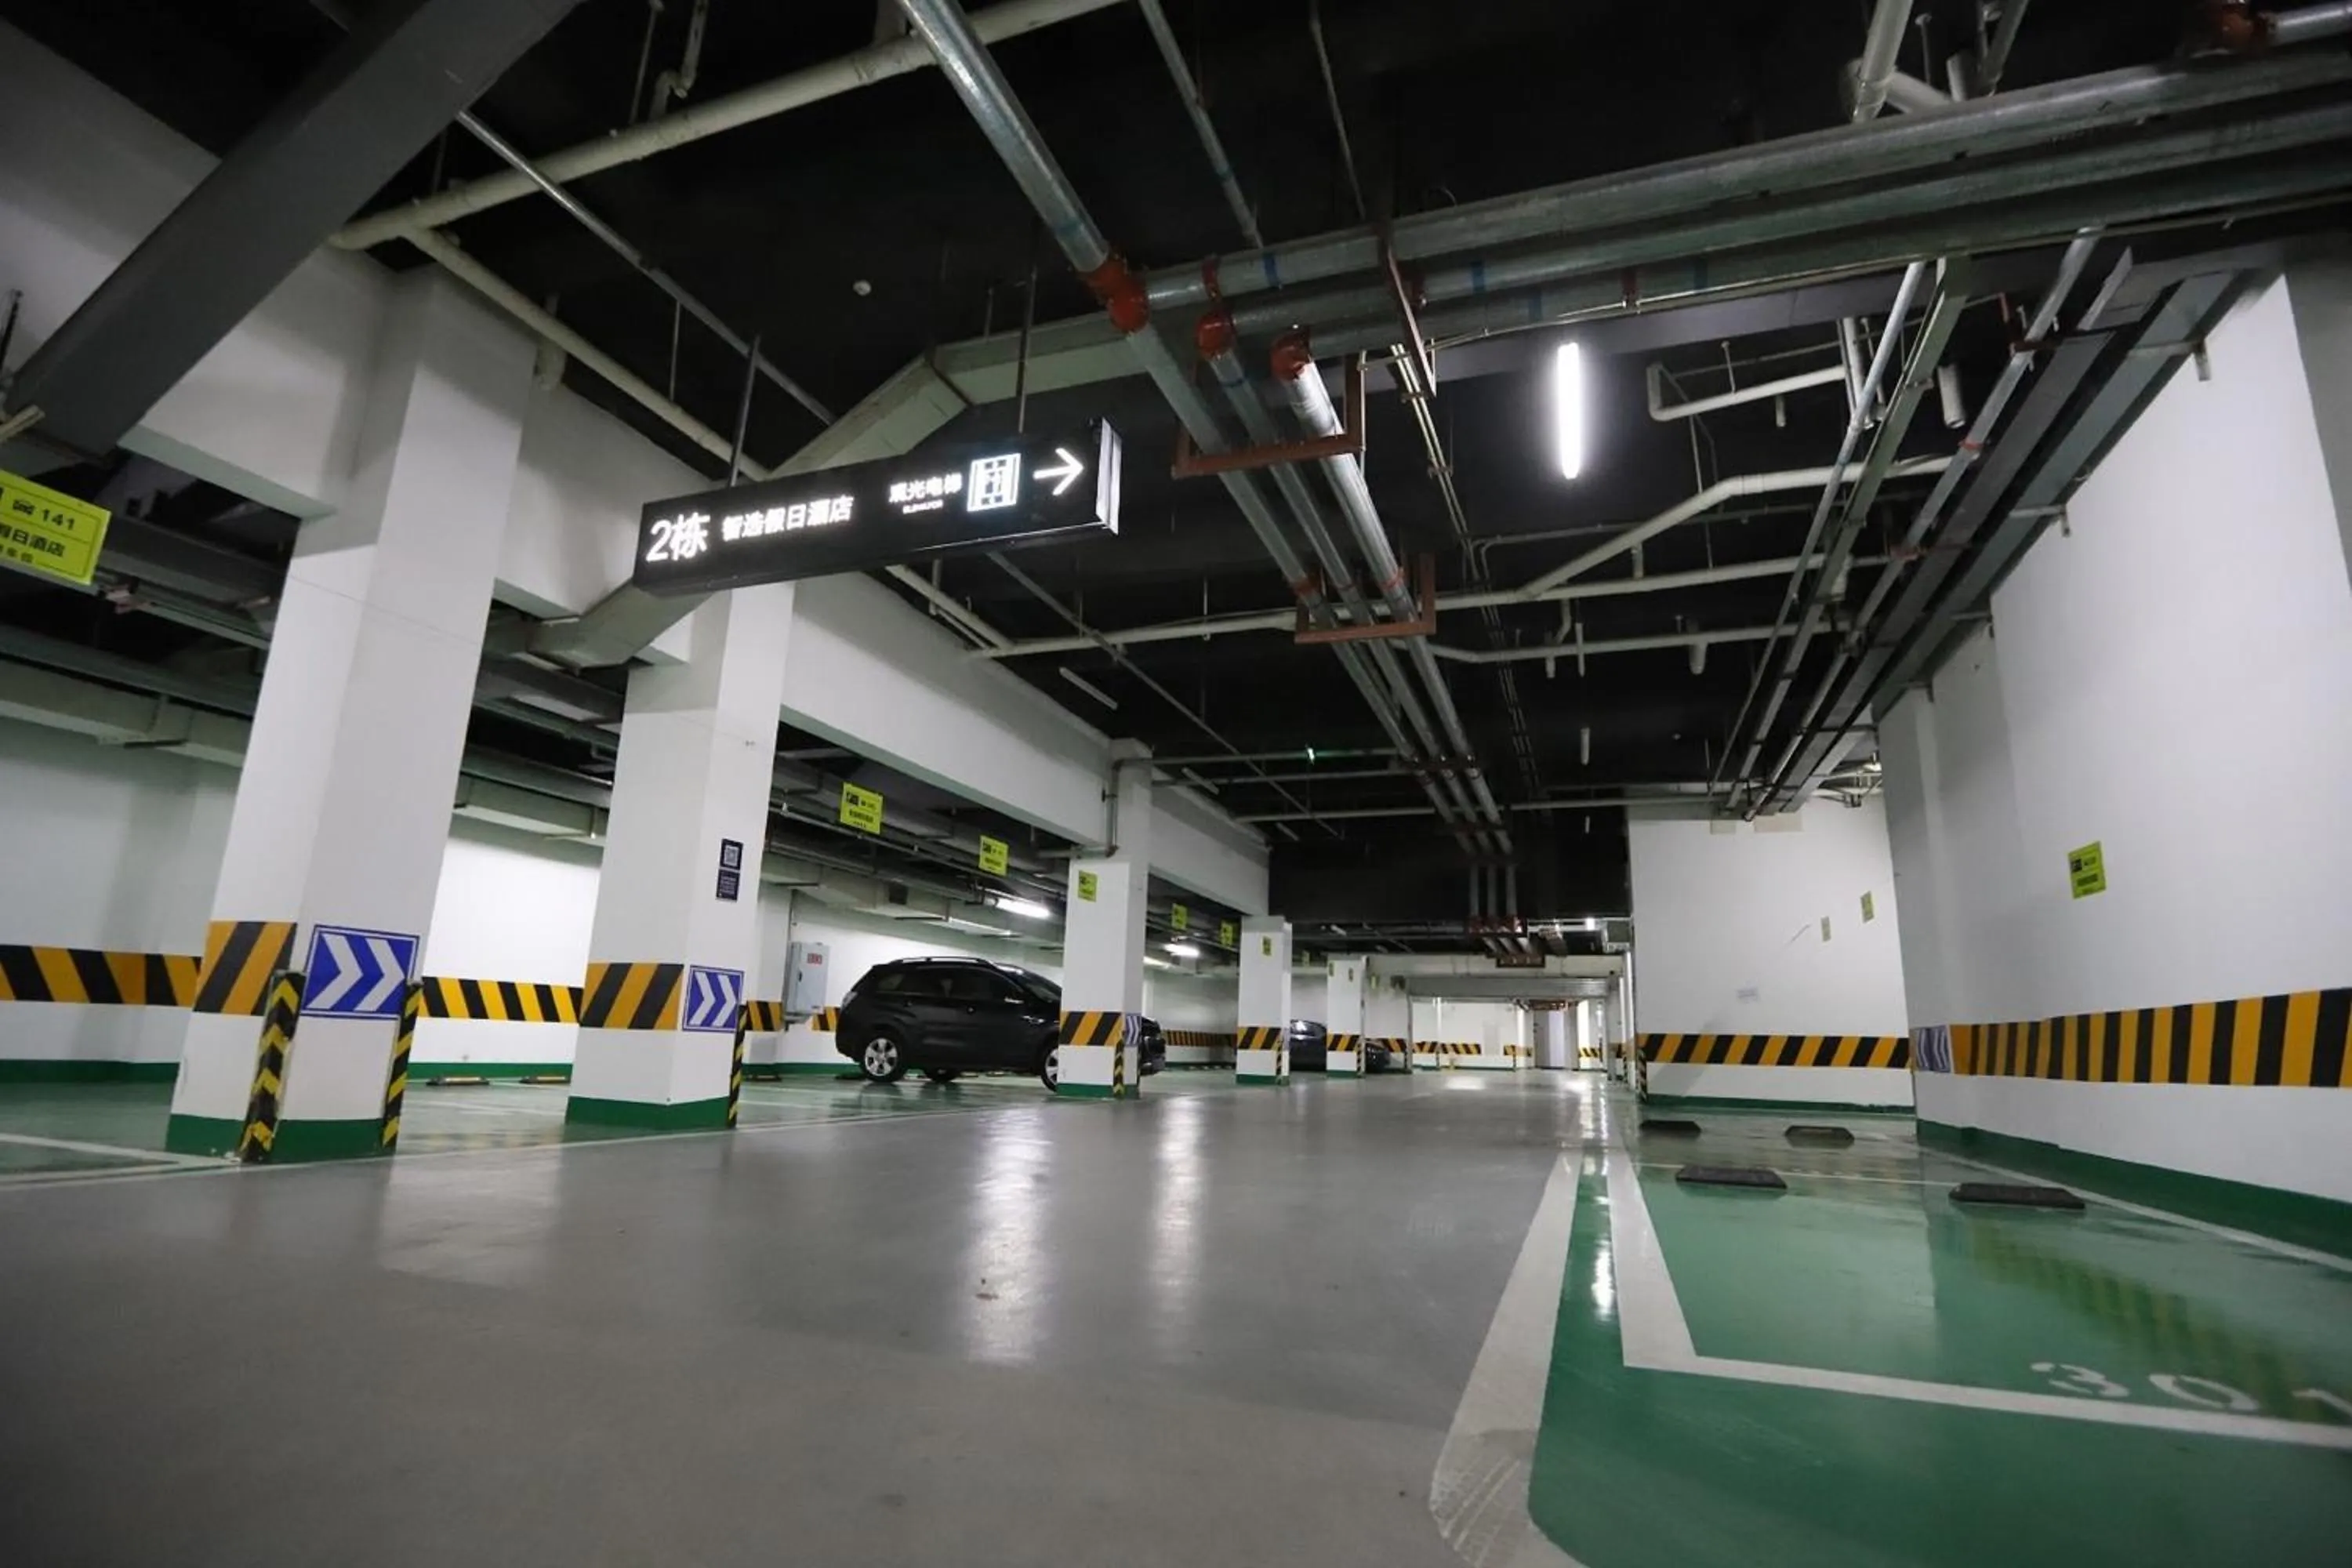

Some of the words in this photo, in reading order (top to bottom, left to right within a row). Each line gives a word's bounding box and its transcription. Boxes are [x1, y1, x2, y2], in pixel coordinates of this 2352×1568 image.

[42, 508, 75, 531] 141
[646, 512, 711, 562] 2栋
[721, 495, 854, 542] 智选假日酒店
[2030, 1361, 2352, 1418] 301
